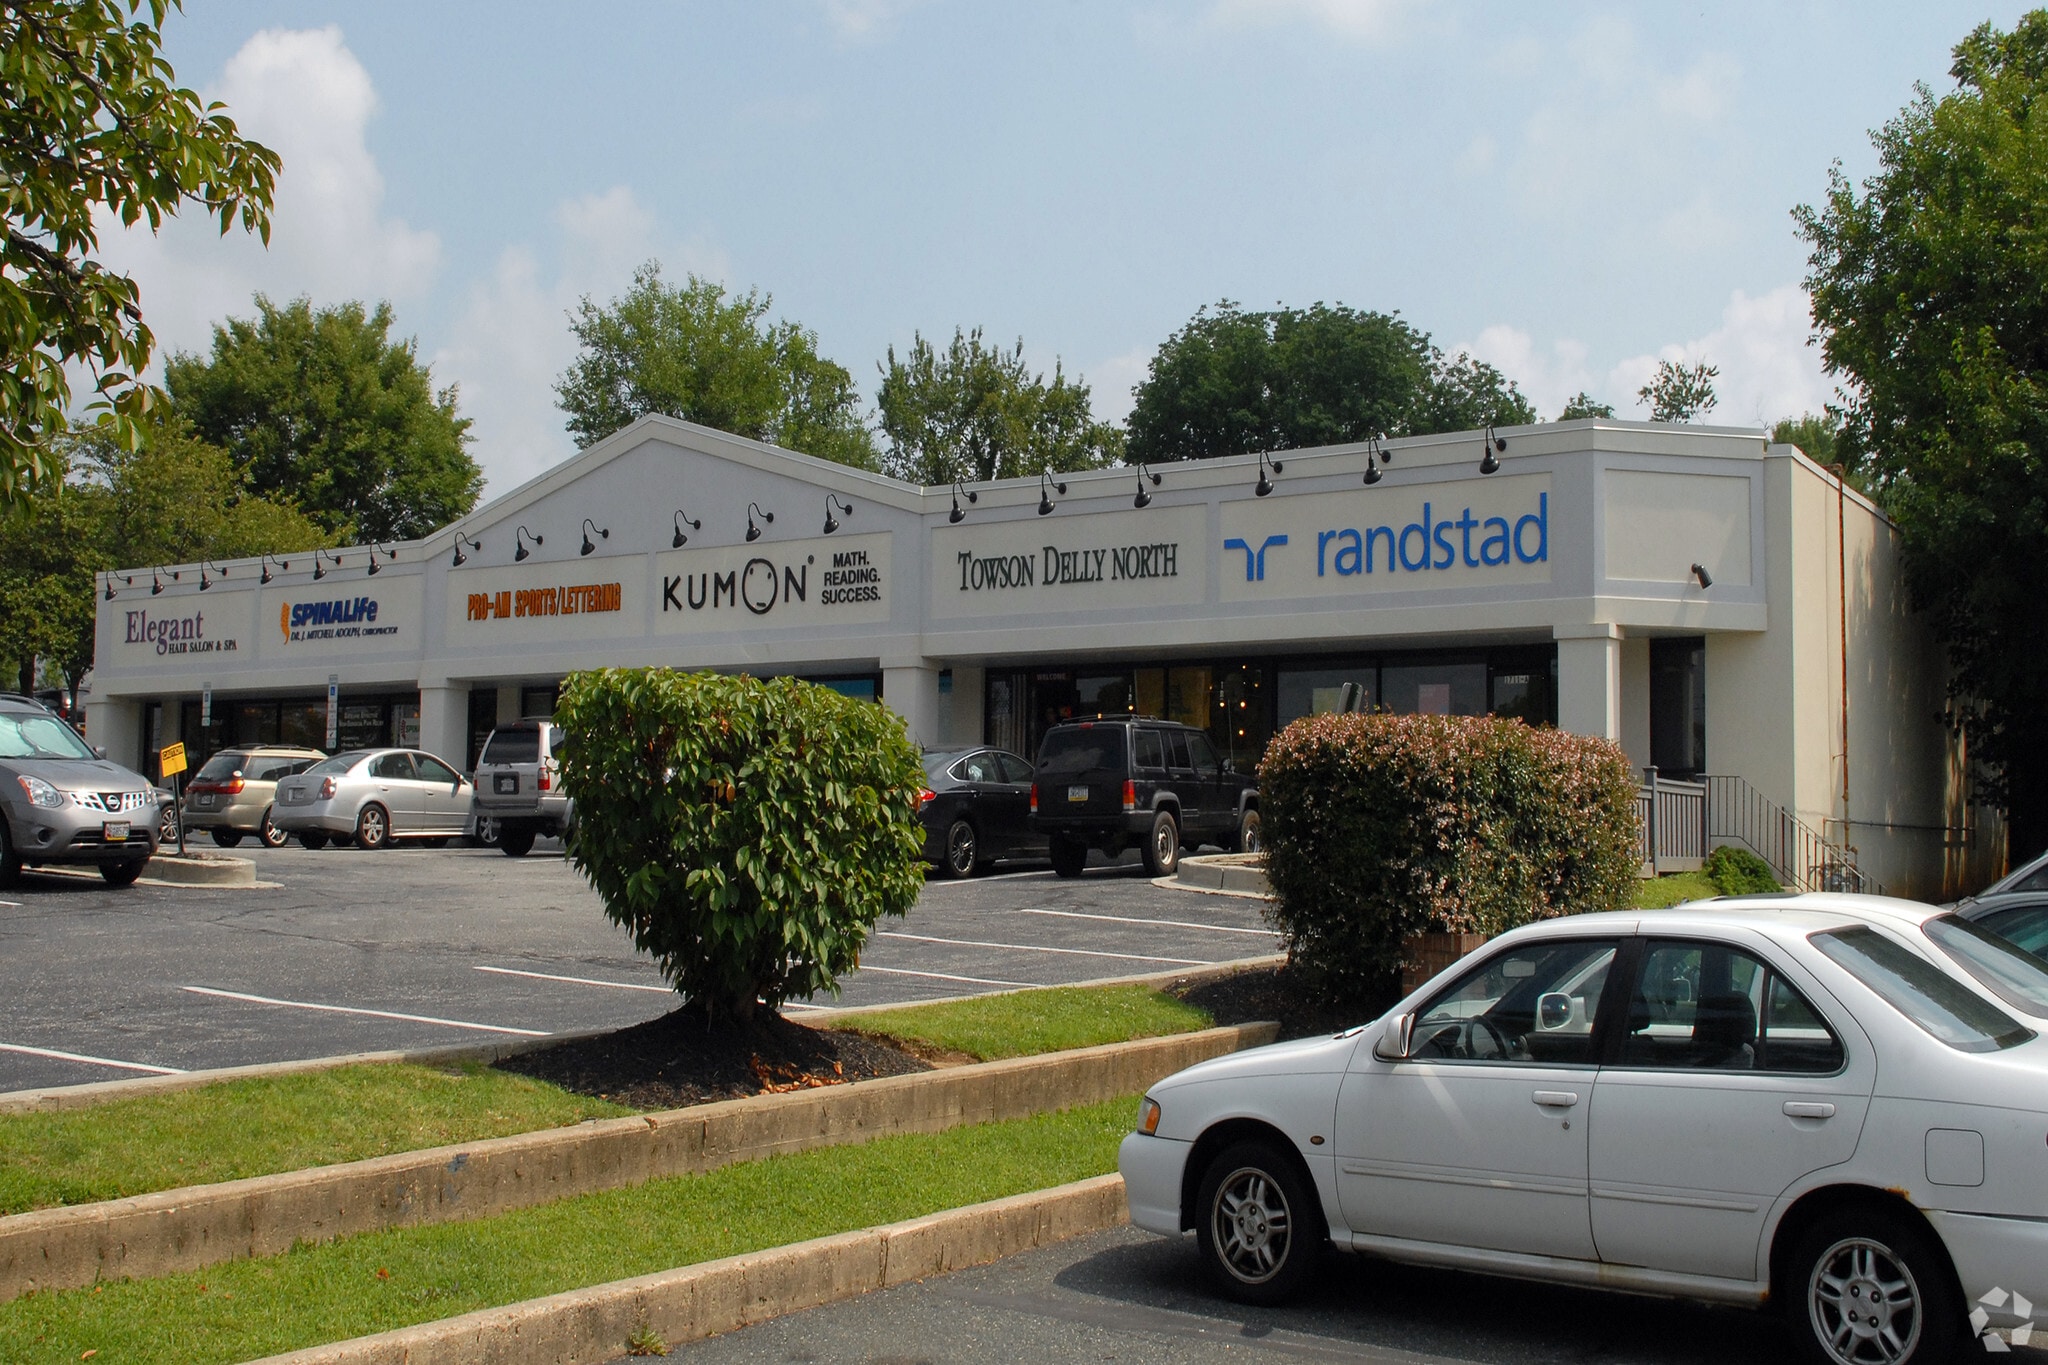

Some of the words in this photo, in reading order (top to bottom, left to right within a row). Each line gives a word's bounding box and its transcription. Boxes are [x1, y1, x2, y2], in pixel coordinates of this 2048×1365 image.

[1317, 492, 1549, 577] randstad
[823, 567, 881, 587] READING.
[833, 551, 870, 570] MATH.
[957, 551, 1036, 591] TOWSON
[1042, 546, 1107, 586] DELLY
[1111, 542, 1178, 581] NORTH
[467, 589, 512, 621] PRO-AM
[515, 582, 622, 618] SPORTS/LETTERING
[663, 558, 807, 616] KUMON
[821, 585, 881, 606] SUCCESS.
[124, 609, 204, 656] Elegant
[168, 642, 188, 655] HAIR
[189, 640, 214, 653] SALON
[215, 640, 222, 652] &
[223, 639, 238, 651] SPA
